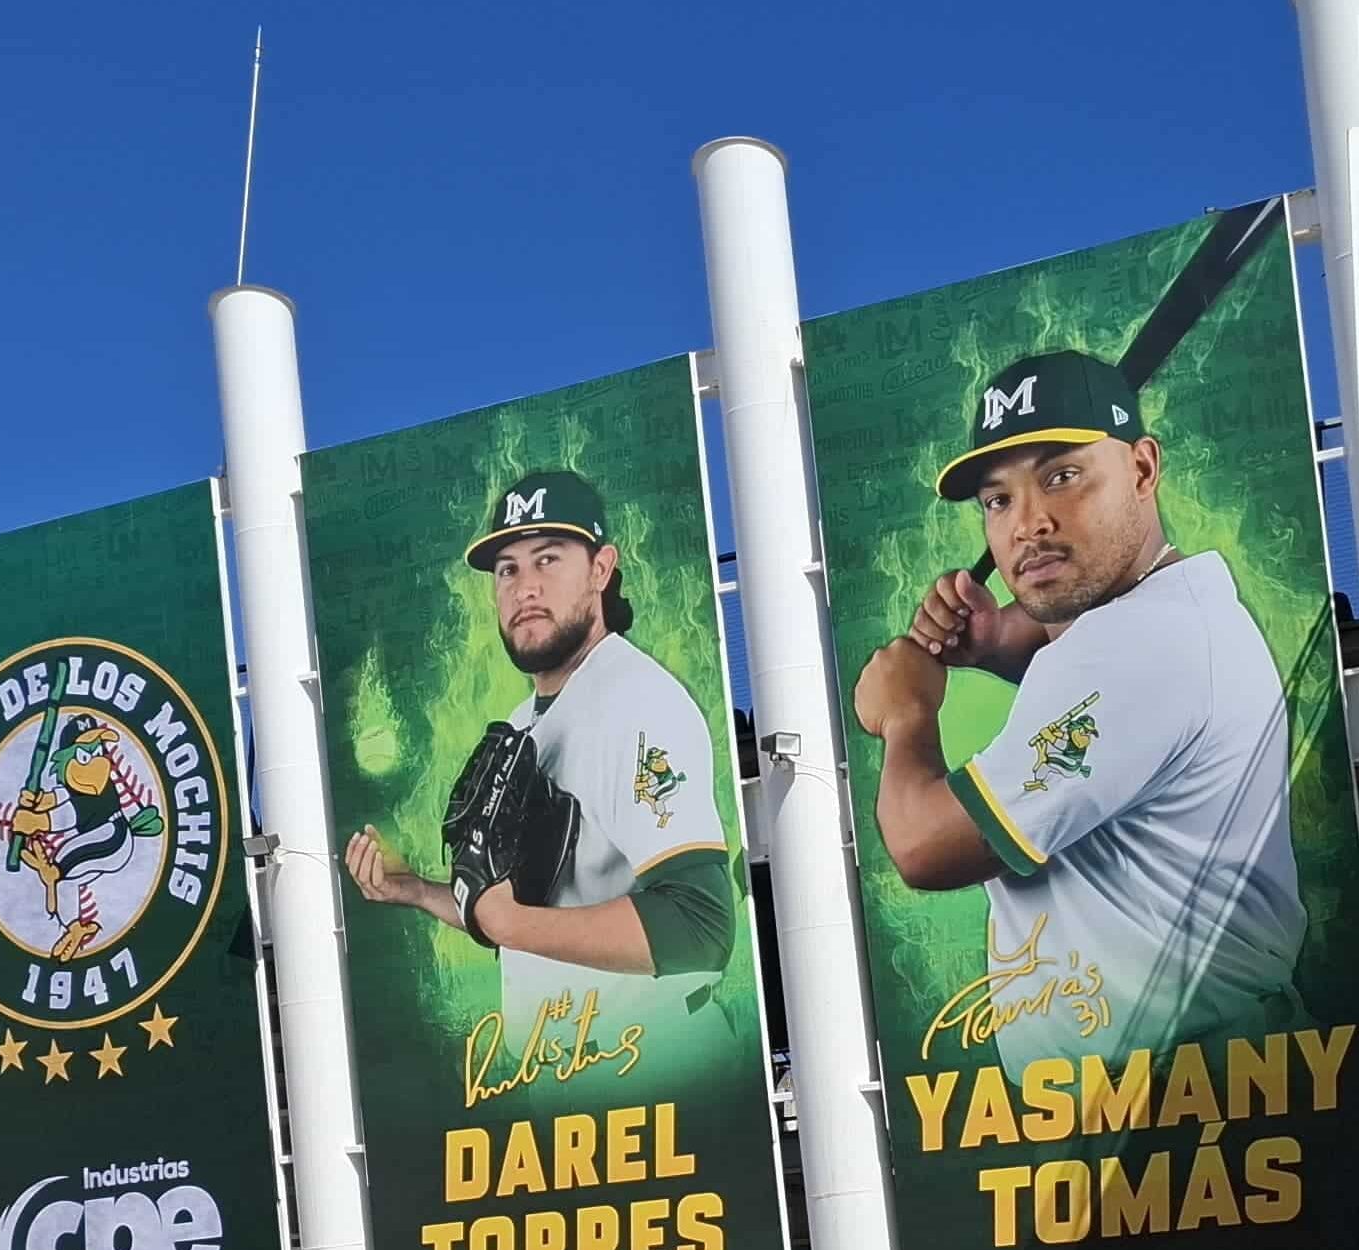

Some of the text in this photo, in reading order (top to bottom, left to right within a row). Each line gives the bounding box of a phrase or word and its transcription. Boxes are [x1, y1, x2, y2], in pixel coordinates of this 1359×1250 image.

[981, 375, 1038, 430] LM
[503, 488, 547, 524] LM
[65, 656, 146, 712] LOS
[144, 701, 213, 906] MOCHIS
[22, 948, 138, 1010] 1947
[905, 1024, 1357, 1152] YASMANY
[83, 1156, 190, 1190] Industrias
[445, 1102, 696, 1203] DAREL
[979, 1121, 1302, 1248] TOMÁS
